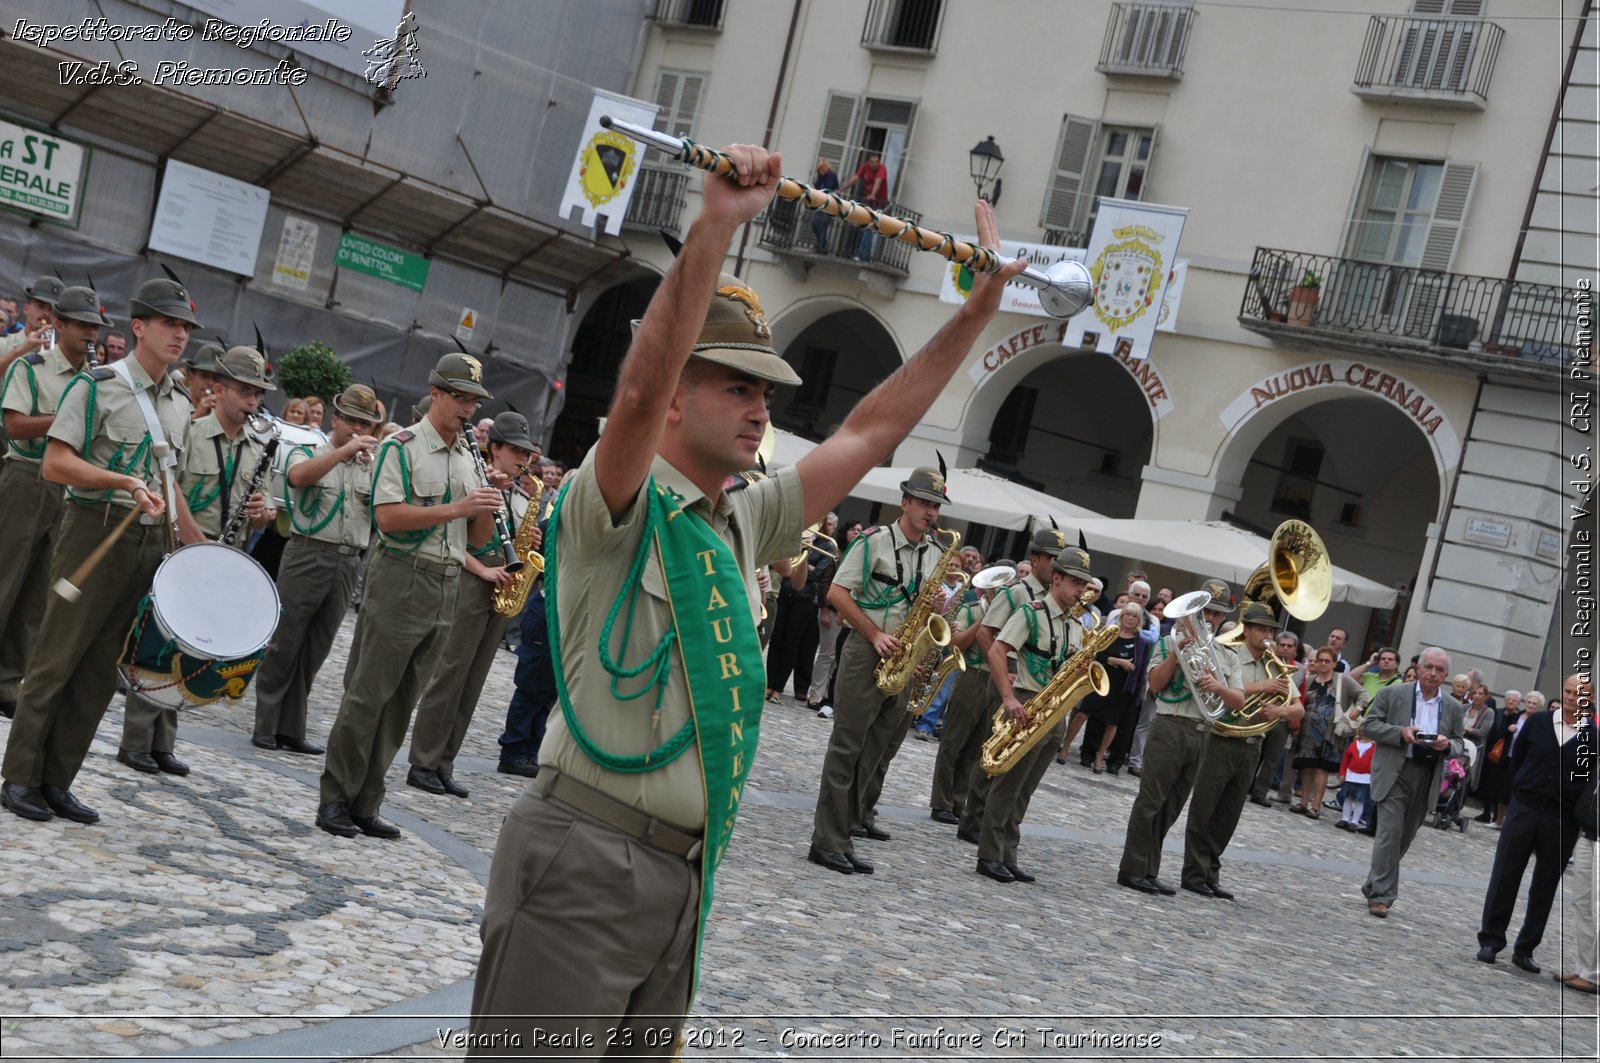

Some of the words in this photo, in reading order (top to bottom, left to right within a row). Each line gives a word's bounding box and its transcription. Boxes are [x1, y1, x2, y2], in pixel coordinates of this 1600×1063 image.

[22, 135, 60, 170] ST
[0, 164, 71, 200] ERALE
[339, 248, 350, 259] OF
[342, 236, 372, 254] UNITED
[373, 246, 405, 265] COLORS
[1017, 247, 1050, 266] Palio
[1251, 363, 1335, 408] NUOVA
[1345, 363, 1443, 435] CERNAIA
